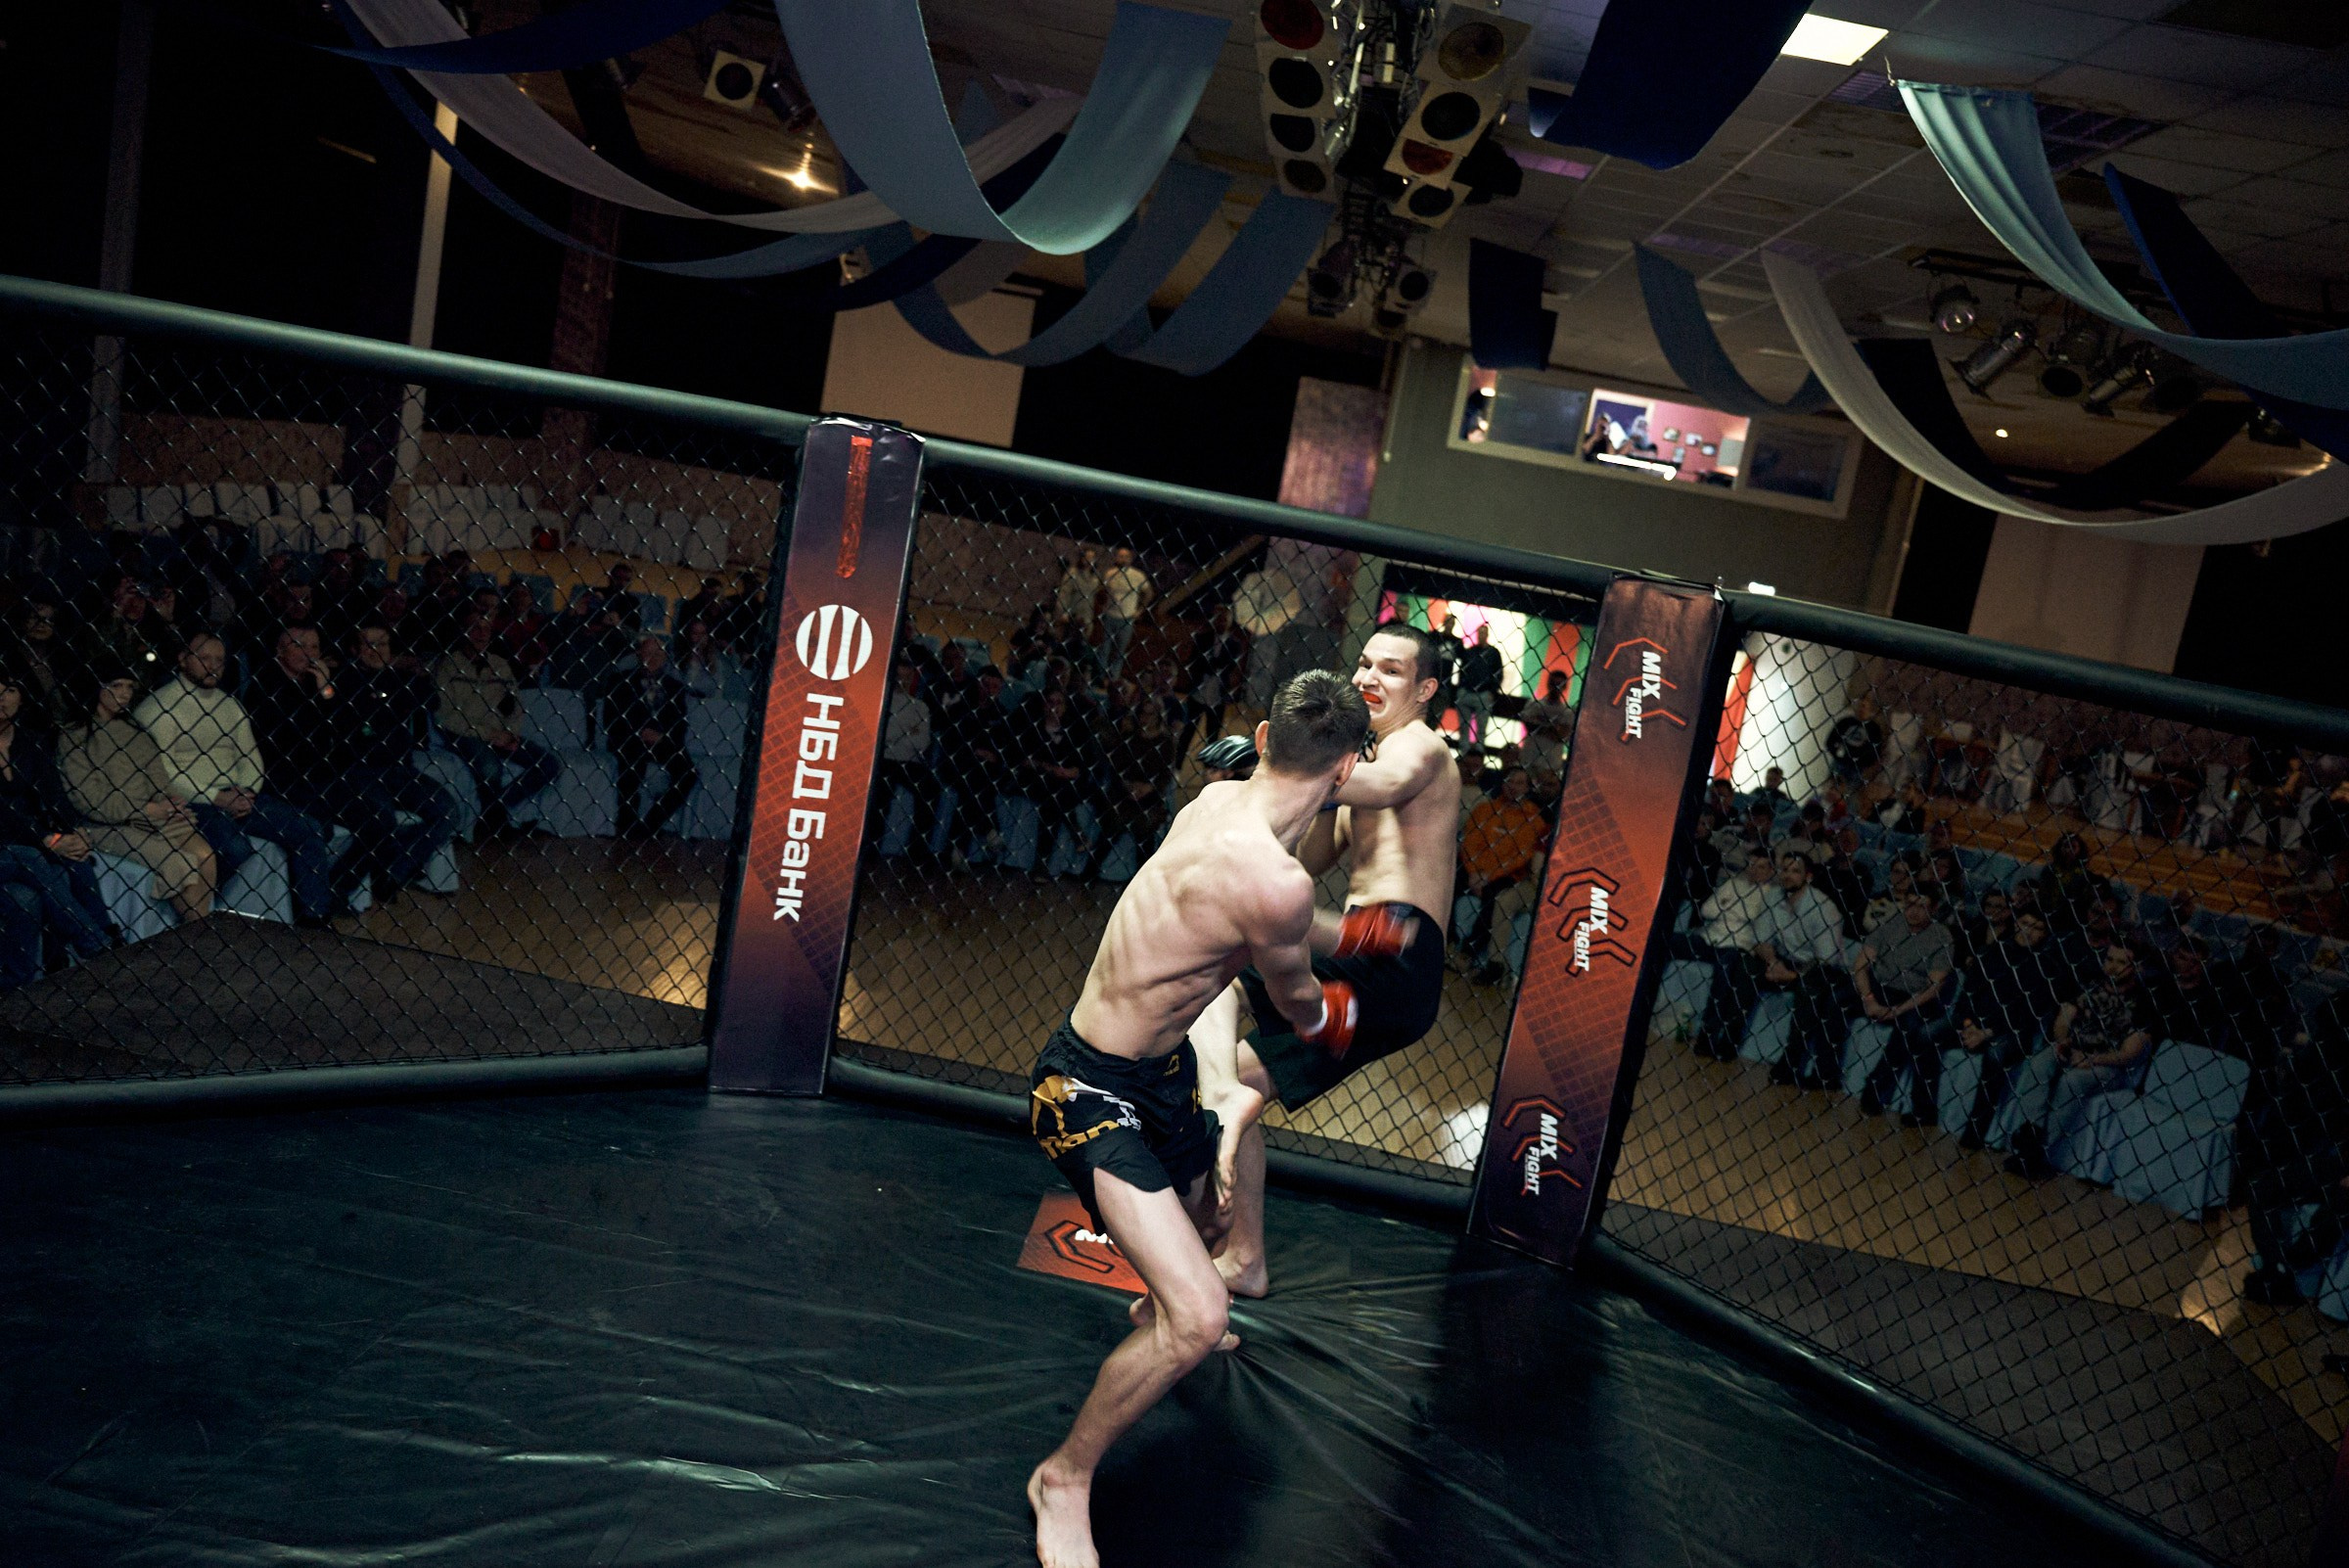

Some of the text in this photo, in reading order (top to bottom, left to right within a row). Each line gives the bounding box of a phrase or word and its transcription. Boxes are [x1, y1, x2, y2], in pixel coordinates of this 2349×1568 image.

[1641, 650, 1661, 701] MIX
[1627, 687, 1642, 740] FIGHT
[773, 692, 845, 923] НБД Банк
[1589, 886, 1609, 936] MIX
[1575, 921, 1590, 972] FIGHT
[1540, 1112, 1558, 1162] MIX
[1525, 1145, 1541, 1196] FIGHT
